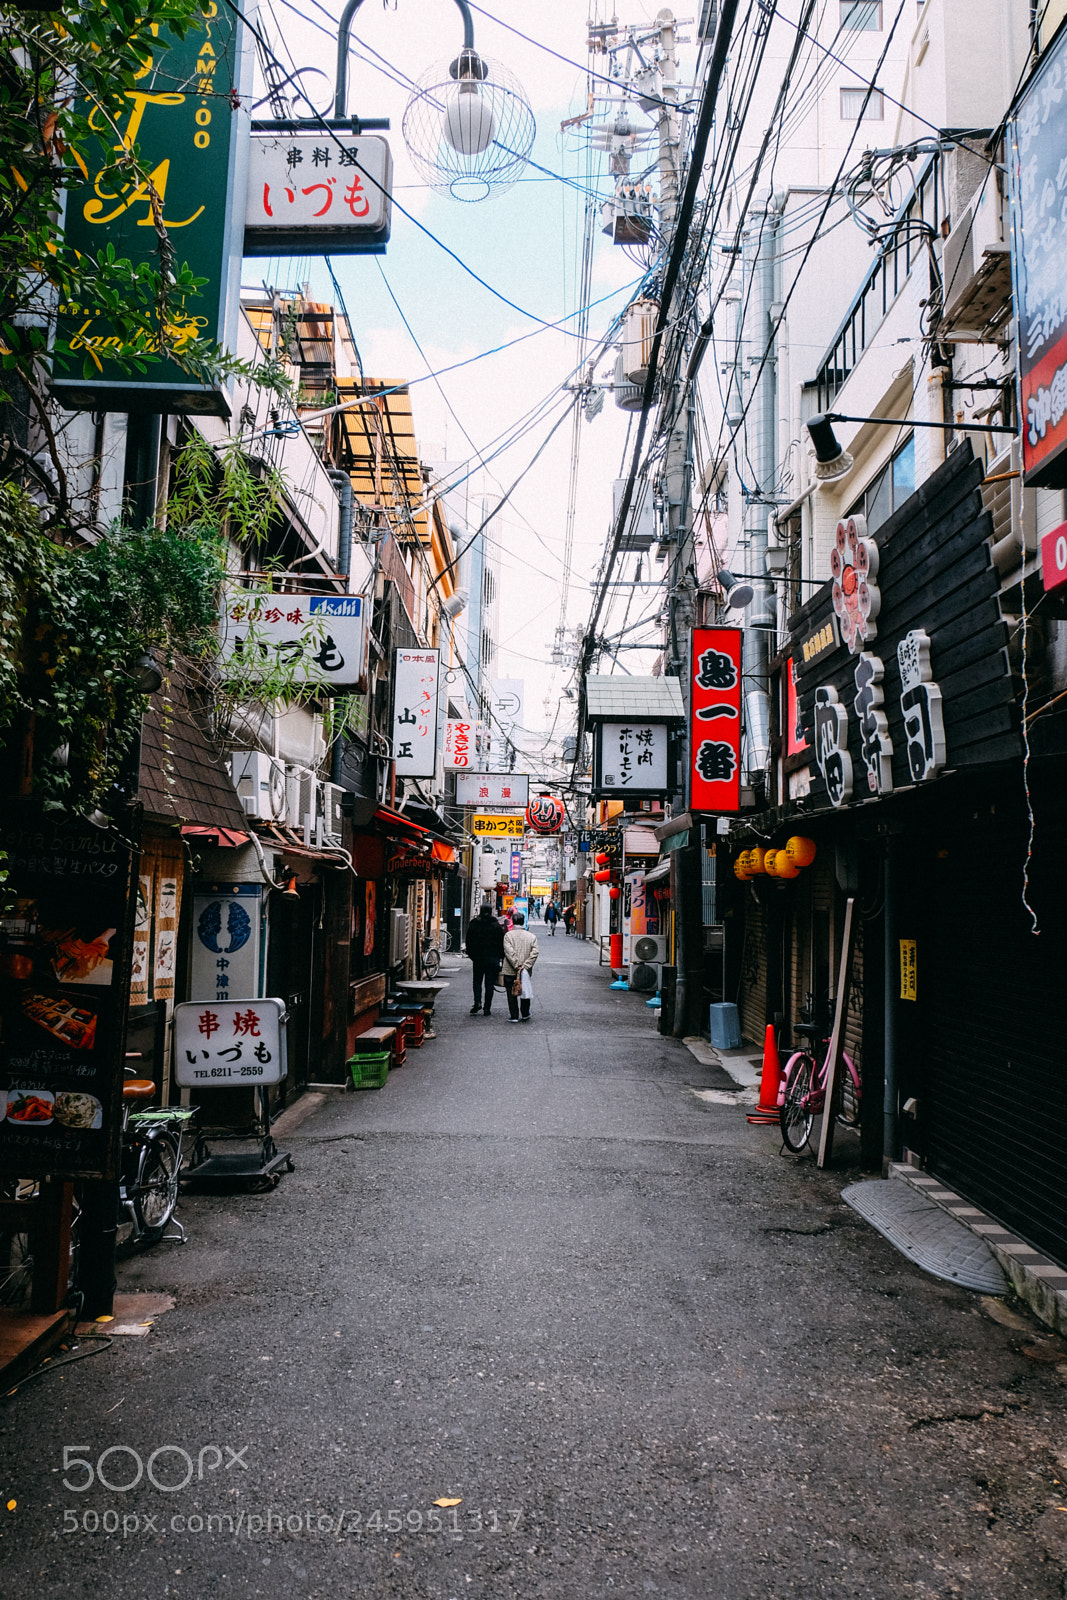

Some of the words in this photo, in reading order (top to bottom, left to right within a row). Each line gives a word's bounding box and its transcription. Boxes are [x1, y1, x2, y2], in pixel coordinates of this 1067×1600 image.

[286, 146, 361, 169] 串料理
[263, 174, 371, 218] いづも
[314, 599, 358, 617] Asahi
[397, 707, 417, 759] 山正
[635, 728, 656, 766] 焼肉
[619, 728, 633, 785] ホルモン
[474, 819, 507, 832] 串かつ
[198, 1009, 262, 1040] 串焼
[185, 1041, 272, 1064] いづも
